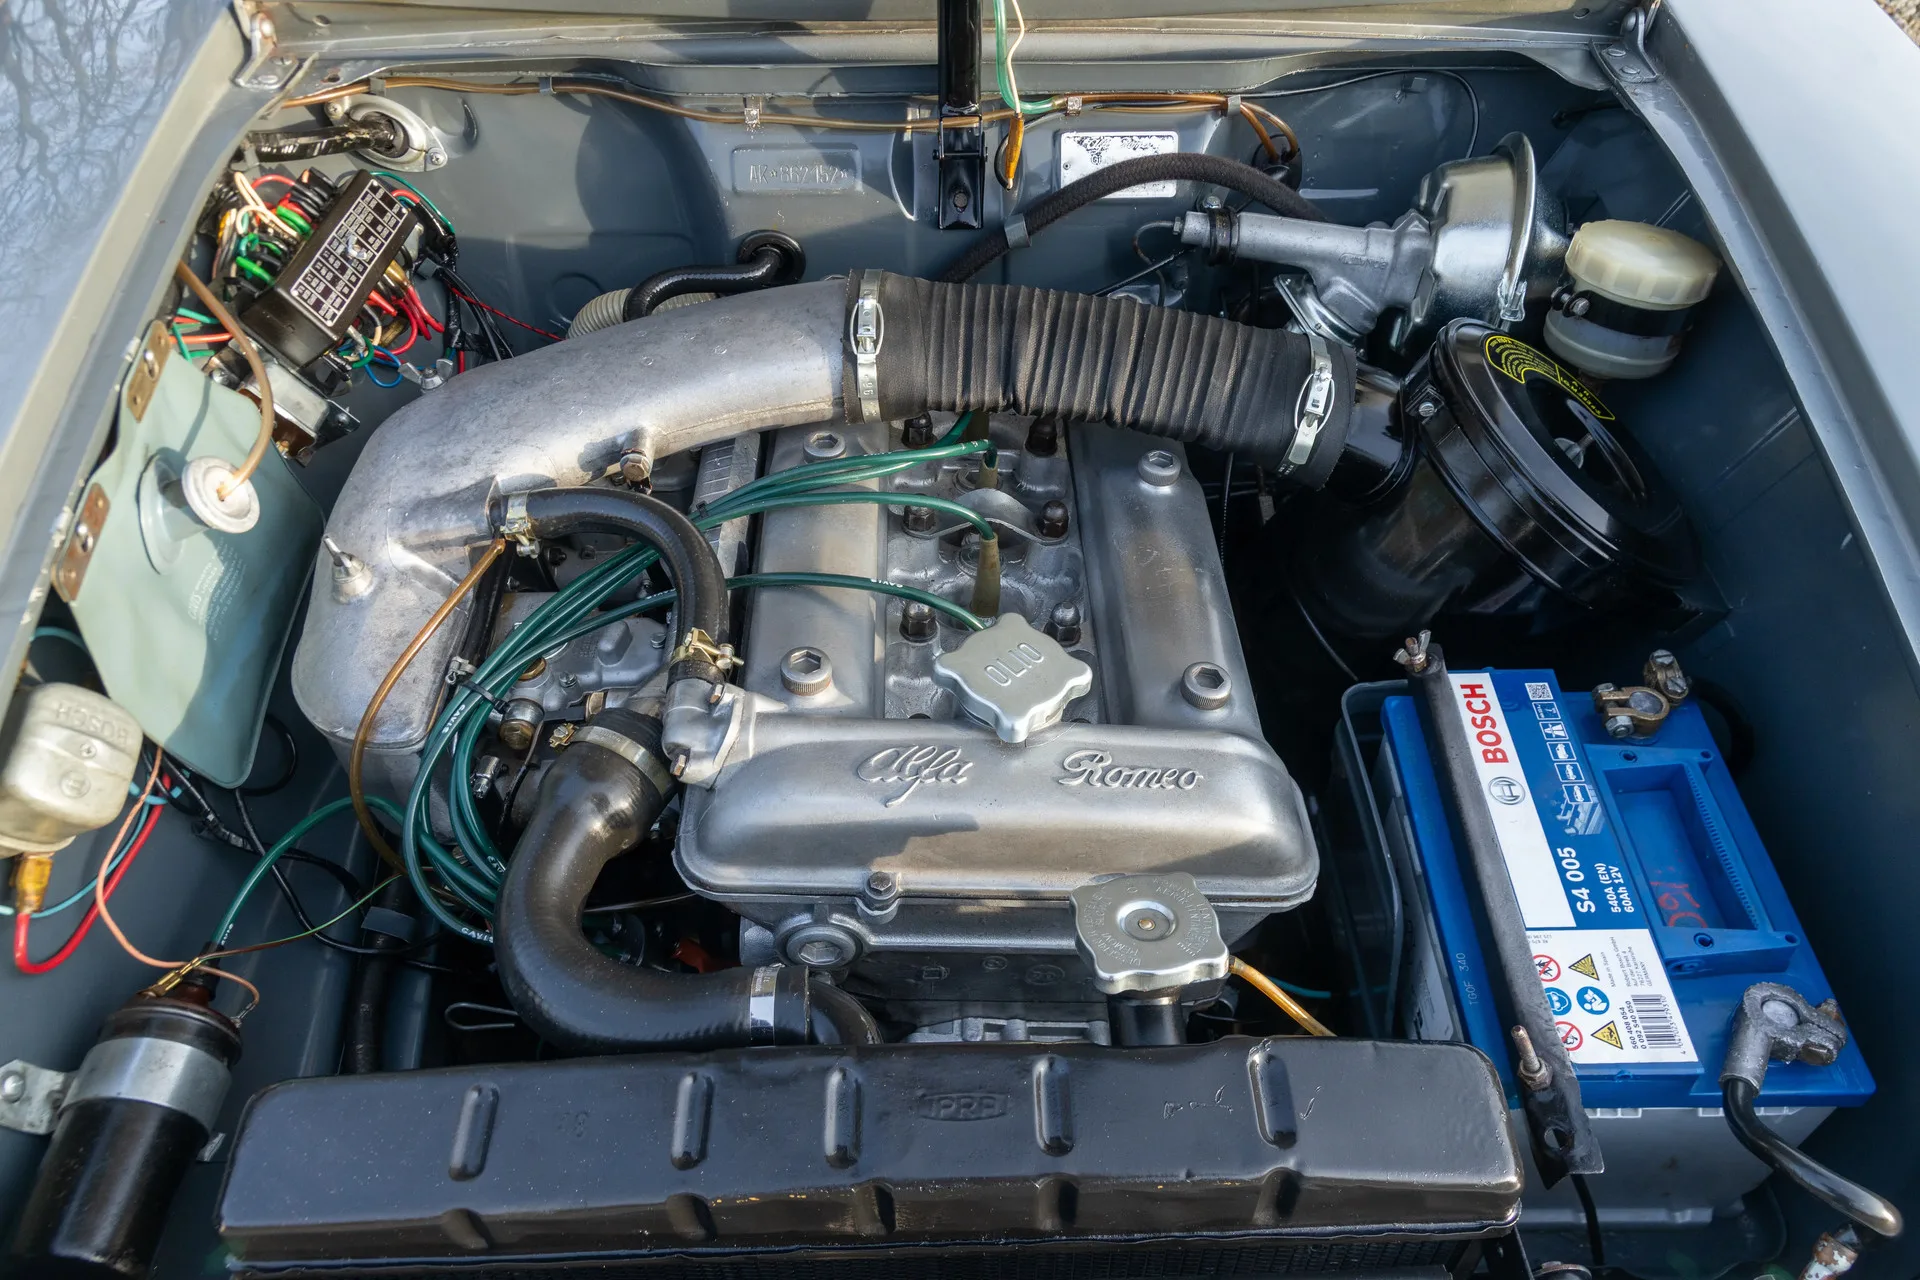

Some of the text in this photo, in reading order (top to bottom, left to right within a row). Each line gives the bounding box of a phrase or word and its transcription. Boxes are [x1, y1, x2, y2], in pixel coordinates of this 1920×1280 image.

[984, 642, 1045, 687] OLIO
[1459, 683, 1510, 764] BOSCH
[857, 744, 1204, 809] Alfa Romeo
[1556, 847, 1596, 913] S4 005
[1594, 863, 1621, 913] 540A (EN)
[1608, 865, 1634, 913] 60Ah 12V
[1619, 1006, 1639, 1049] 560 408 054
[1625, 1000, 1634, 1014] 050
[1635, 1030, 1645, 1043] 092
